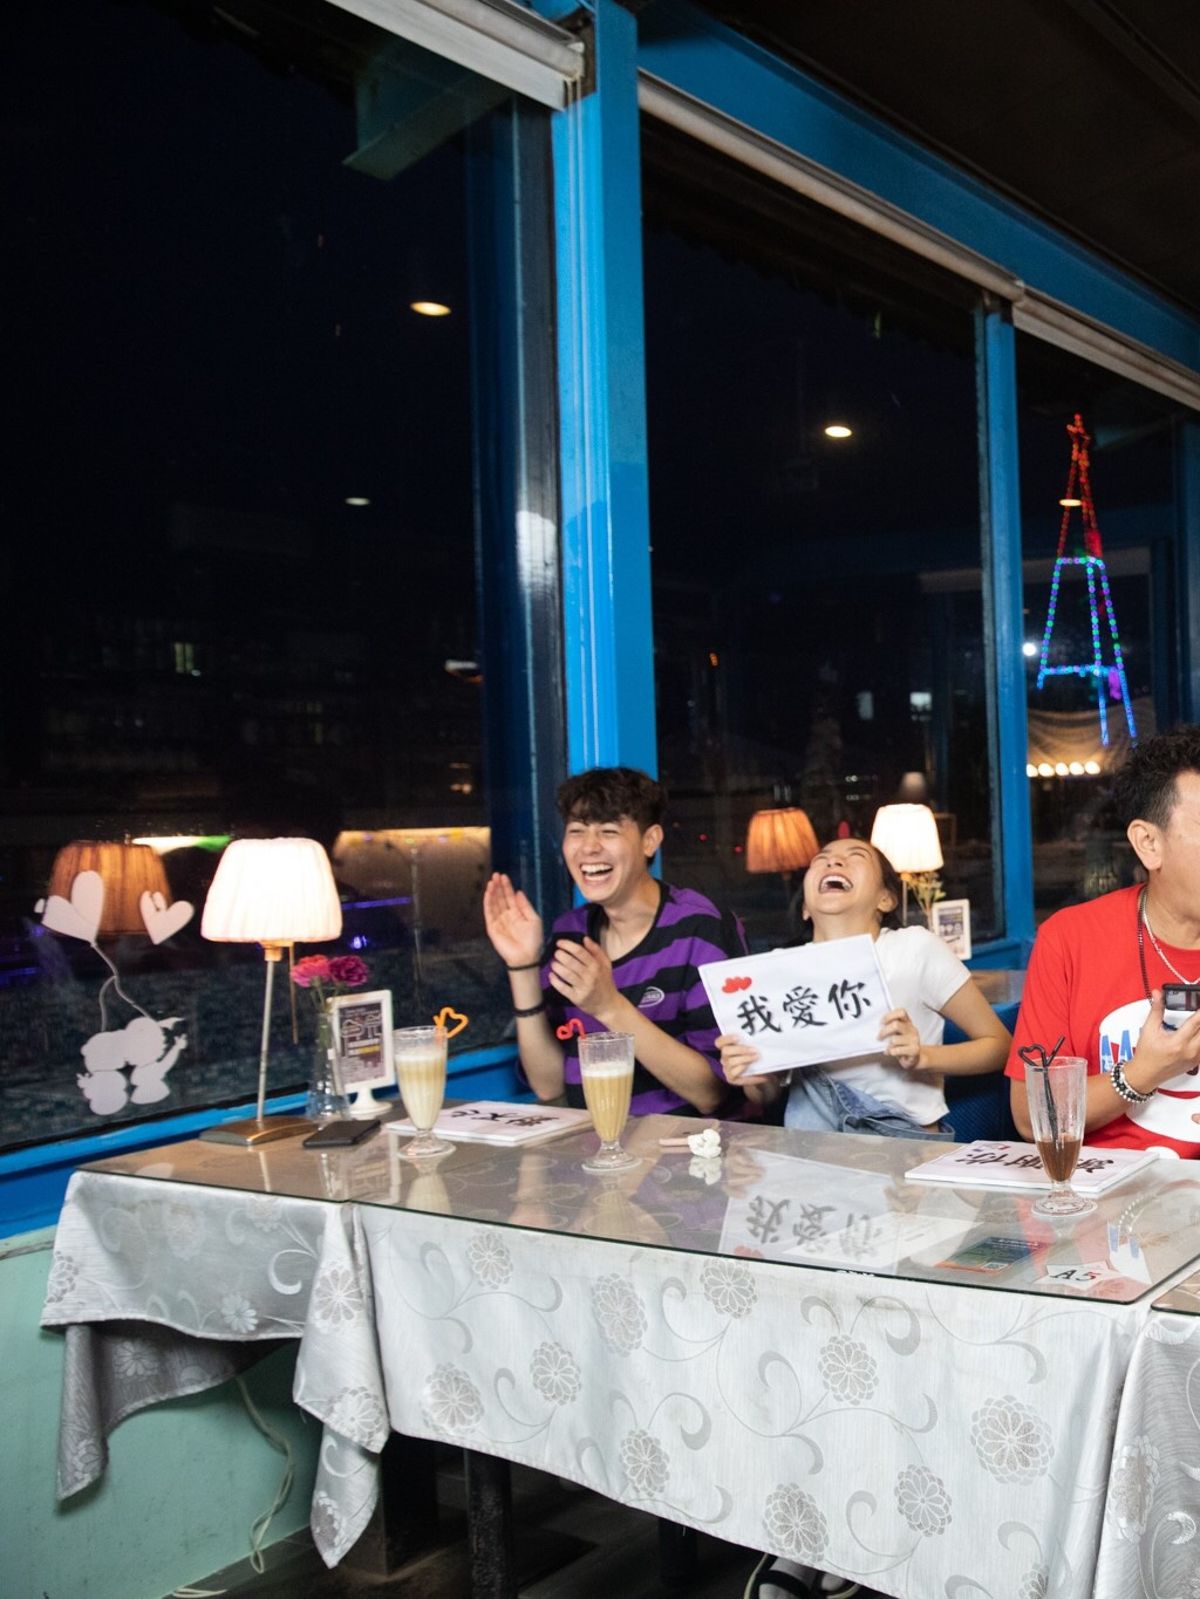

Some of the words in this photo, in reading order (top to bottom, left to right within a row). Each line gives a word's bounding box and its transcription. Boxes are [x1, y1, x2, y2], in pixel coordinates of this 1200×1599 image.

[737, 978, 872, 1036] 我愛你
[1050, 1268, 1101, 1282] A5
